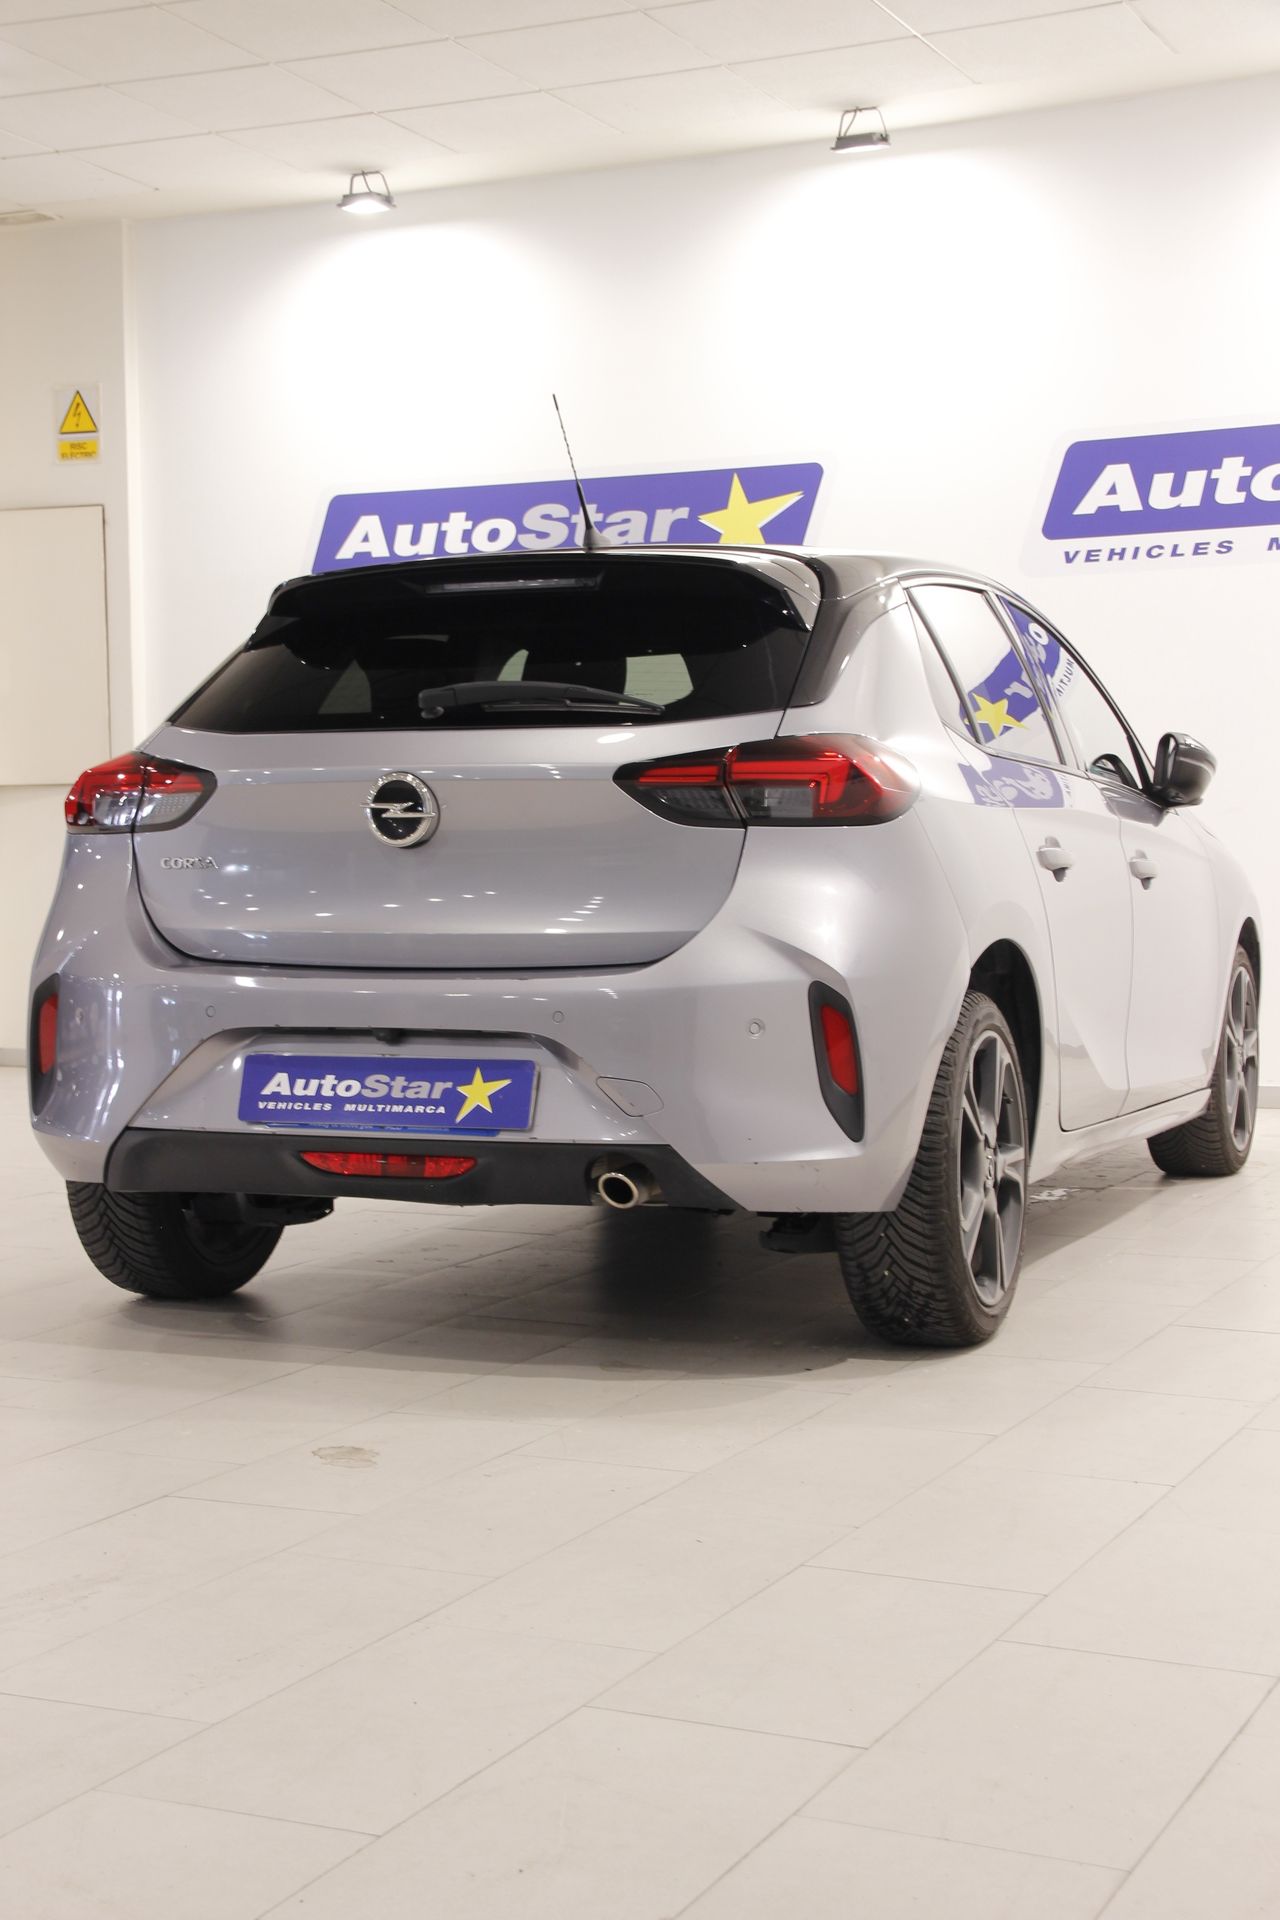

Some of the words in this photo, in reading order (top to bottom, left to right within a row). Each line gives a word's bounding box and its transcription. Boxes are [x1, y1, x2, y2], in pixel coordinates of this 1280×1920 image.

[334, 503, 690, 559] AutoStar
[1064, 540, 1234, 564] VEHICLES
[260, 1072, 453, 1099] AutoStar
[257, 1101, 333, 1111] VEHICLES
[343, 1103, 446, 1114] MULTIMARCA
